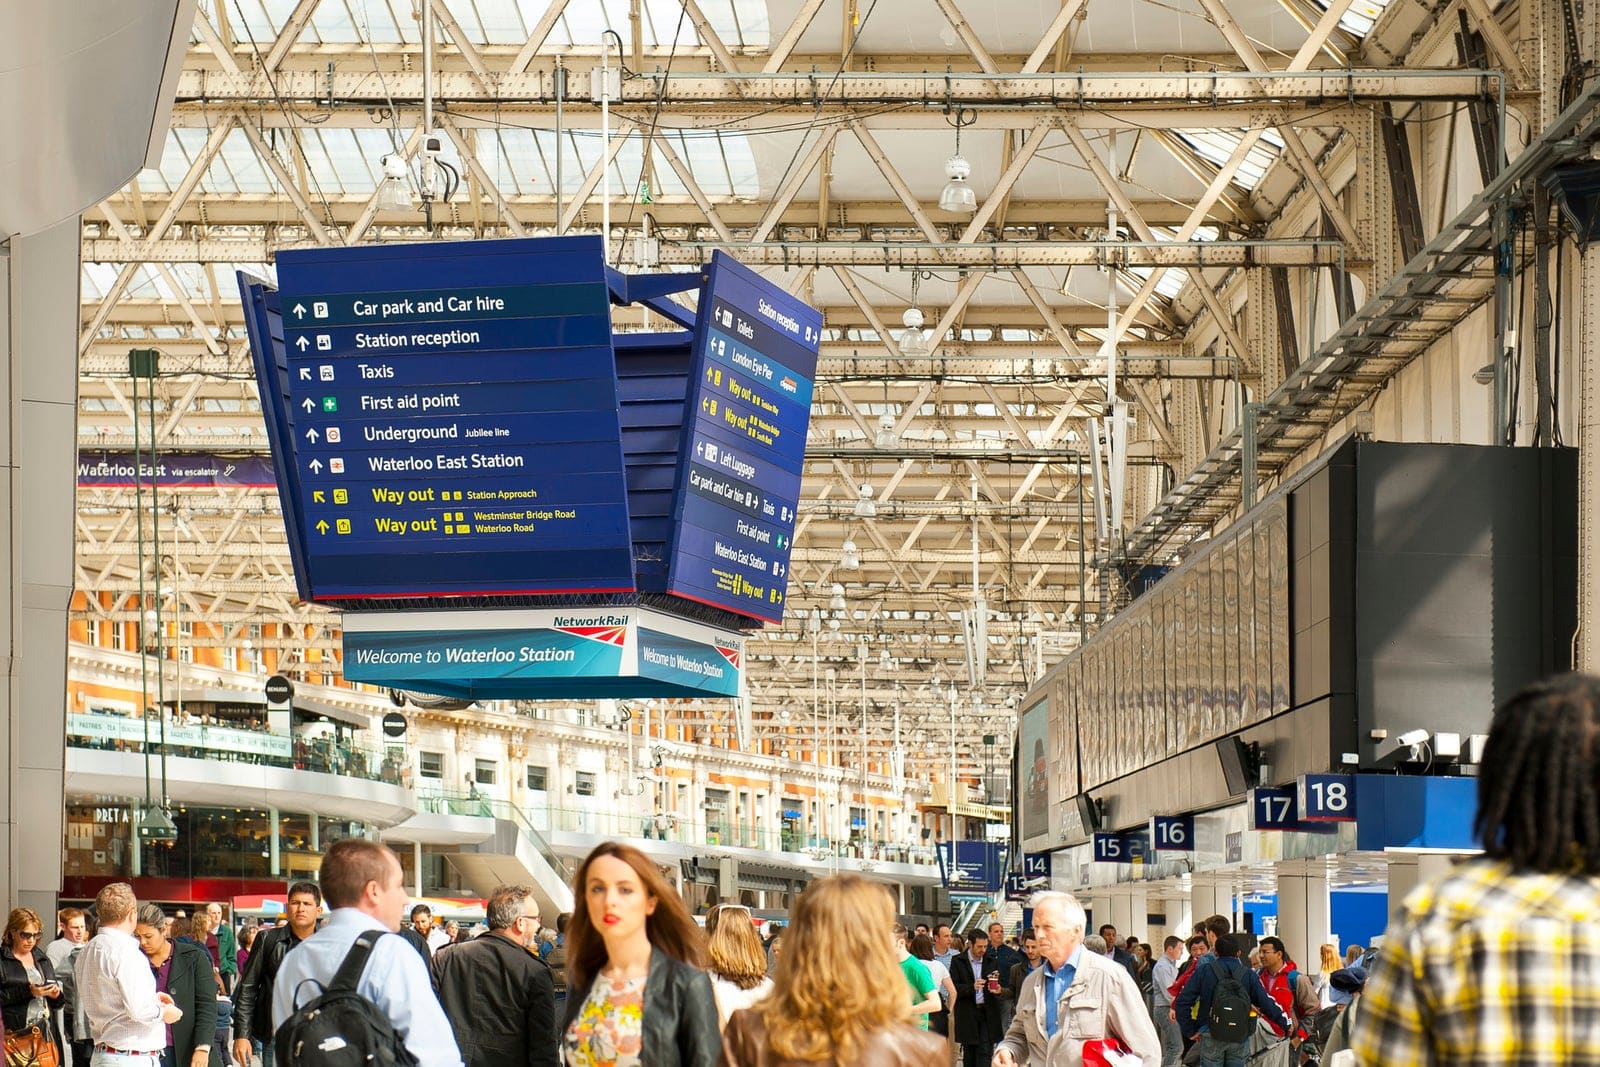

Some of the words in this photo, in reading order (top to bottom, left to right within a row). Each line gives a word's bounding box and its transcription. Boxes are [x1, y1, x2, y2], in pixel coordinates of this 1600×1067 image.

[354, 301, 380, 316] Car
[382, 300, 413, 318] park
[417, 299, 444, 314] and
[448, 298, 473, 312] Car
[477, 296, 504, 311] hire
[759, 299, 777, 322] Station
[777, 312, 800, 334] reception
[737, 318, 754, 340] Toilets
[356, 332, 407, 349] Station
[411, 330, 480, 346] reception
[358, 364, 394, 379] Taxis
[732, 349, 751, 369] London
[752, 358, 762, 376] Eye
[762, 362, 773, 380] Pier
[730, 378, 741, 398] Way
[741, 386, 751, 401] out
[361, 395, 394, 410] First
[397, 394, 418, 408] aid
[422, 392, 460, 410] point
[725, 407, 737, 426] Way
[738, 414, 747, 430] out
[364, 425, 458, 443] Underground
[465, 427, 492, 438] Jubilee
[494, 428, 509, 437] line
[78, 464, 135, 477] Waterloo
[140, 464, 166, 477] East
[184, 468, 218, 476] escalator
[368, 456, 433, 471] Waterloo
[437, 455, 467, 470] East
[471, 453, 523, 468] Station
[721, 451, 731, 466] Left
[732, 455, 755, 478] Luggage
[467, 490, 496, 500] Station
[498, 489, 537, 500] Approach
[690, 470, 699, 486] Car
[700, 475, 712, 491] park
[713, 480, 724, 495] and
[724, 482, 734, 499] Car
[734, 488, 744, 504] hire
[372, 488, 404, 505] Way
[408, 488, 434, 502] out
[474, 512, 524, 521] Westminster
[526, 510, 552, 520] Bridge
[555, 510, 575, 518] Road
[763, 500, 775, 516] Taxis
[375, 519, 409, 536] Way
[411, 518, 437, 532] out
[475, 524, 512, 533] Waterloo
[513, 523, 534, 532] Road
[737, 520, 748, 536] First
[757, 529, 770, 544] point
[715, 541, 738, 561] Waterloo
[738, 550, 748, 566] East
[749, 553, 766, 571] Station
[742, 581, 753, 599] Way
[754, 586, 764, 599] out
[554, 616, 628, 626] NetworkRail
[714, 636, 741, 648] NetworkRail
[357, 649, 422, 664] Welcome
[426, 650, 441, 663] to
[446, 649, 515, 662] Waterloo
[519, 648, 574, 662] Station
[643, 646, 668, 664] Welcome
[669, 652, 676, 666] to
[677, 654, 702, 673] Waterloo
[703, 659, 723, 678] Station
[1312, 782, 1347, 811] 18
[96, 808, 119, 823] PRET
[122, 808, 128, 823] A
[1261, 796, 1291, 822] 17
[1158, 822, 1185, 844] 16
[1098, 839, 1120, 857] 15
[1026, 857, 1046, 872] 14
[1011, 876, 1028, 890] 13
